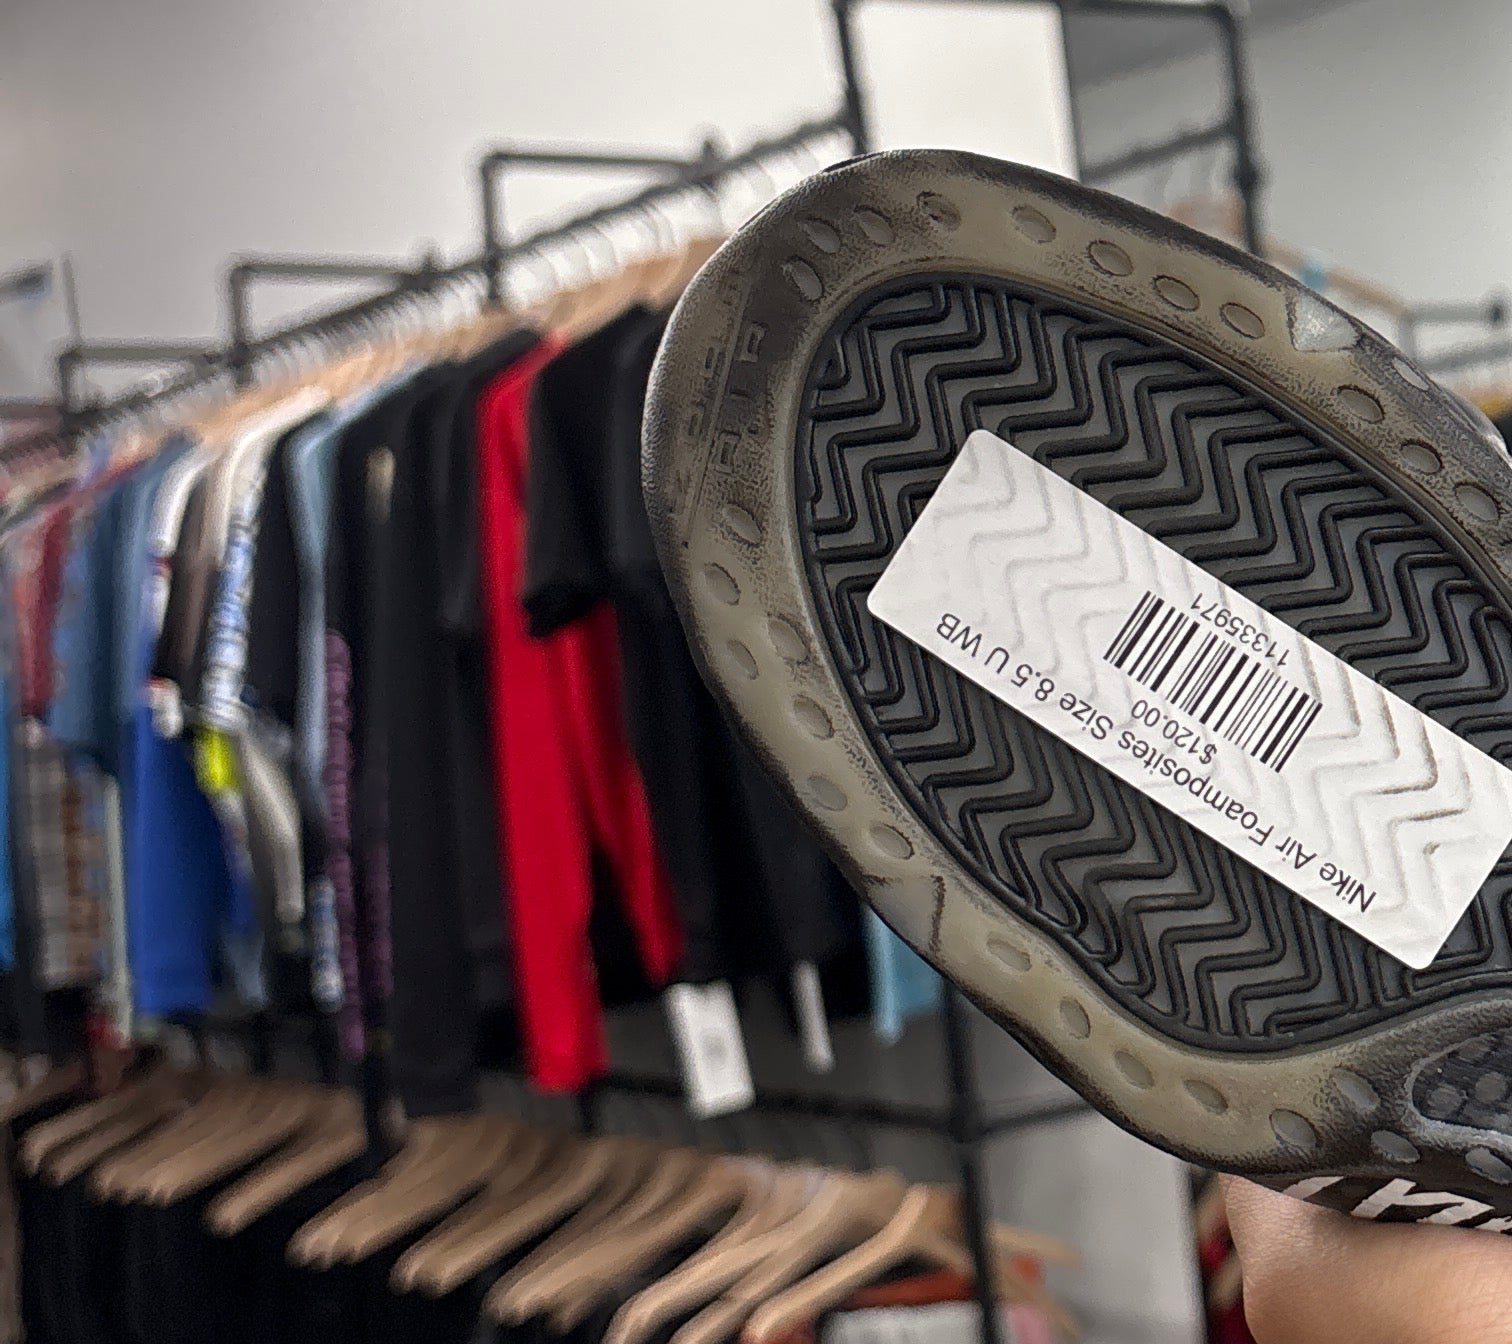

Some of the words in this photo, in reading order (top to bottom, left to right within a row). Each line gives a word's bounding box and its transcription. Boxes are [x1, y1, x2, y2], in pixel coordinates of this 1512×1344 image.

[936, 612, 983, 658] WB
[1190, 592, 1291, 667] 11335971
[983, 646, 1011, 675] U
[1010, 663, 1057, 702] 8.5
[1058, 692, 1115, 741] Size
[1130, 699, 1219, 766] $120.00
[1118, 730, 1275, 845] Foamposites
[1274, 836, 1319, 871] Air
[1319, 862, 1378, 914] Nike
